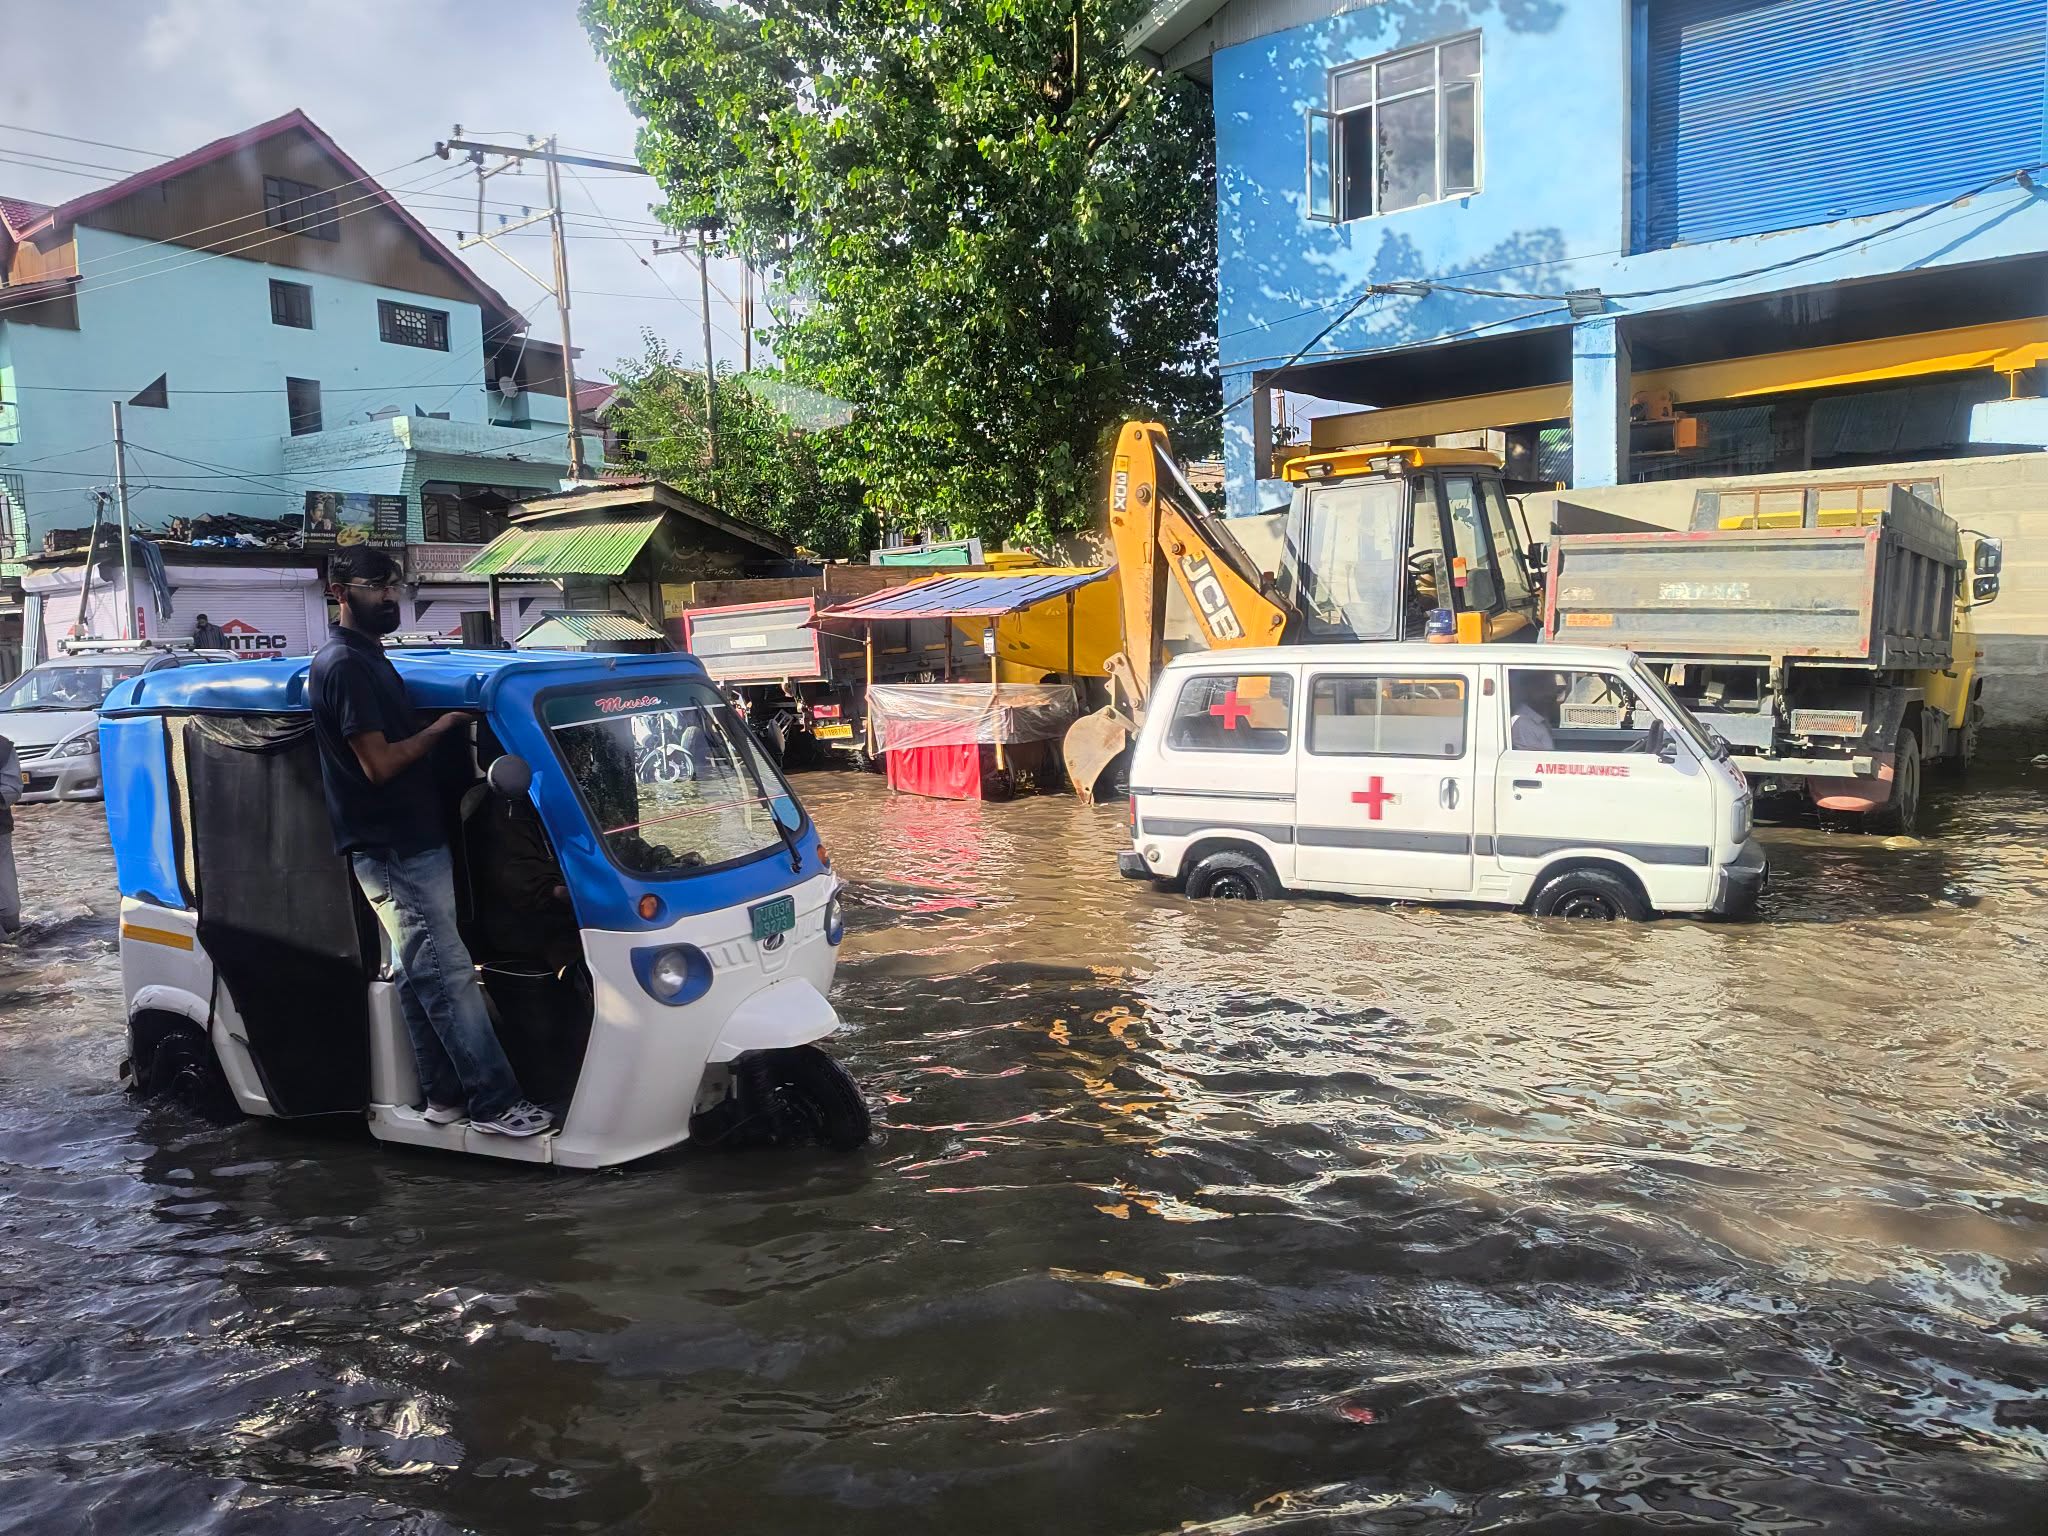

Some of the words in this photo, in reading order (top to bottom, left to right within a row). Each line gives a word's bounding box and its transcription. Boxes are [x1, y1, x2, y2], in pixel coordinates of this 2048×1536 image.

[365, 539, 384, 547] Painter
[384, 539, 389, 547] &
[1181, 554, 1240, 641] JCB
[1535, 763, 1631, 777] AMBULANCE
